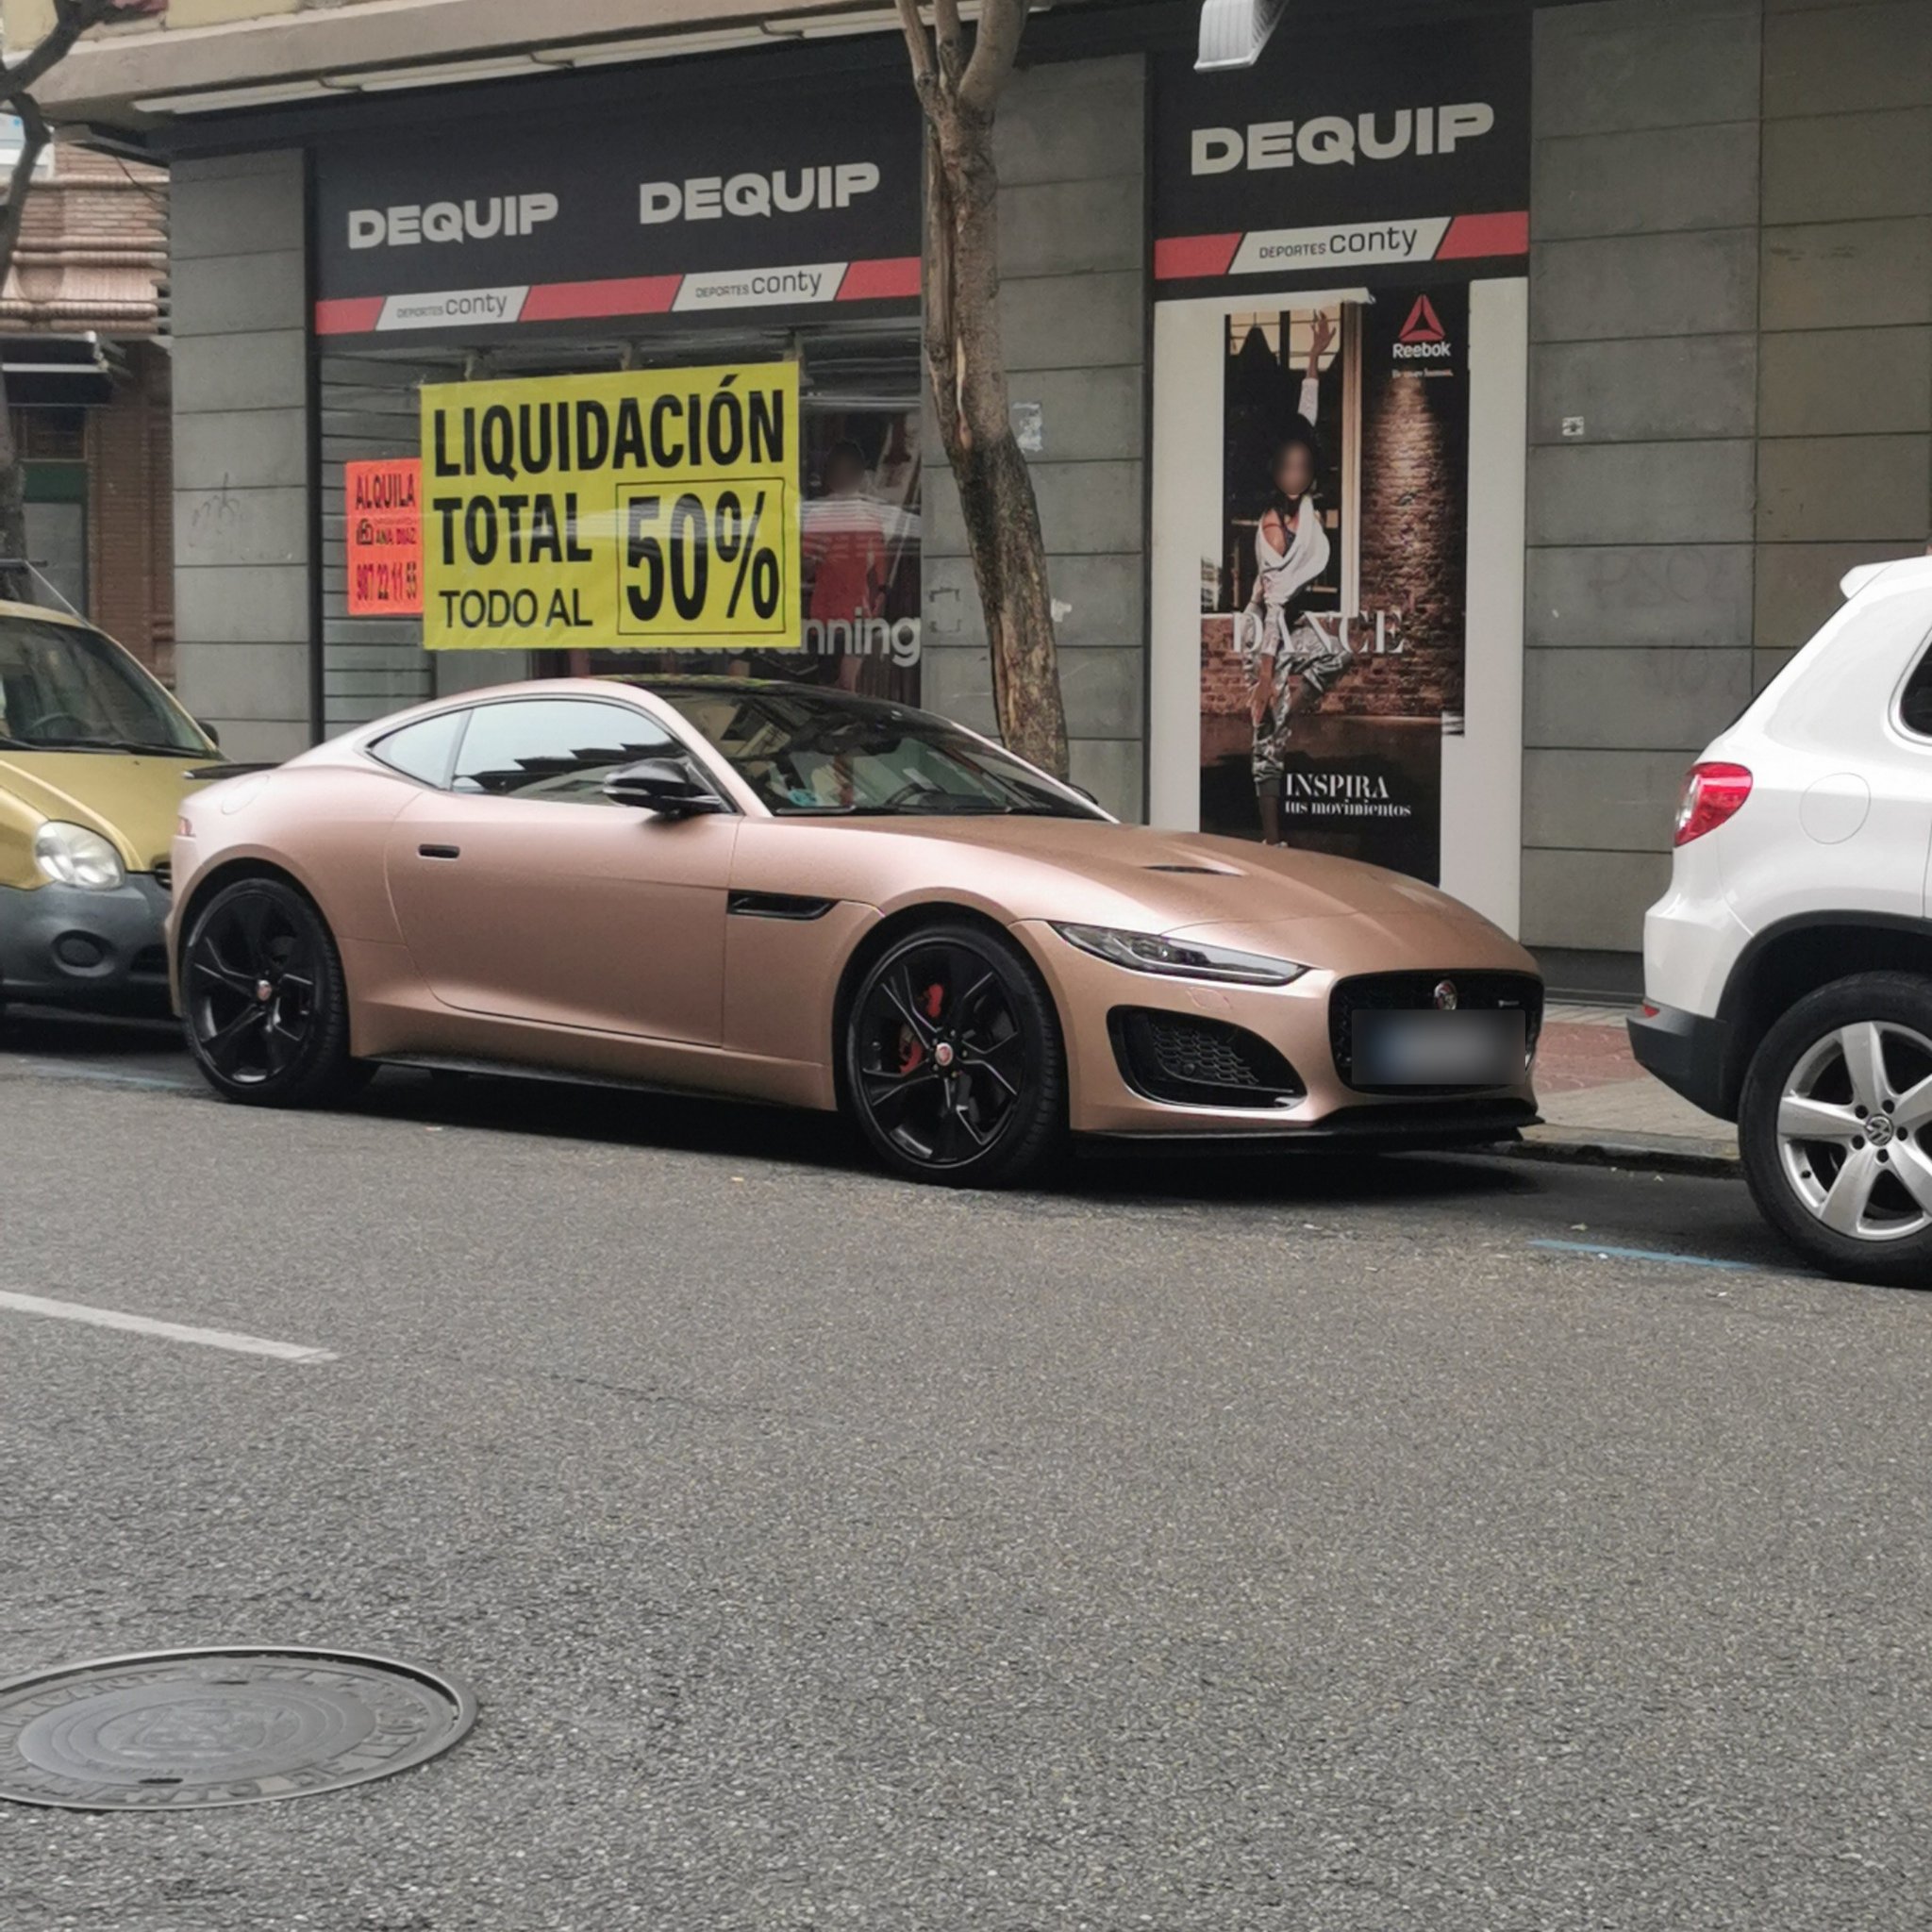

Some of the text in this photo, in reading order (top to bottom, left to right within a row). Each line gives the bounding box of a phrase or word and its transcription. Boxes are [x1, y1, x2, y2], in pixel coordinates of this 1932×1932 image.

[1191, 101, 1494, 175] DEQUIP
[639, 161, 880, 225] DEQUIP
[348, 192, 559, 250] DEQUIP
[1258, 225, 1418, 259] DEPORTES conty
[694, 270, 823, 298] DEPORTES conty
[445, 293, 508, 318] conty
[1392, 341, 1452, 358] Reebok
[433, 374, 784, 481] LIQUIDACIÓN
[356, 473, 416, 509] ALQUILA
[433, 491, 592, 566] TOTAL
[625, 490, 780, 623] 50%
[439, 587, 593, 629] TODO AL
[1286, 773, 1390, 799] INSPIRA
[1311, 798, 1412, 817] movimientos
